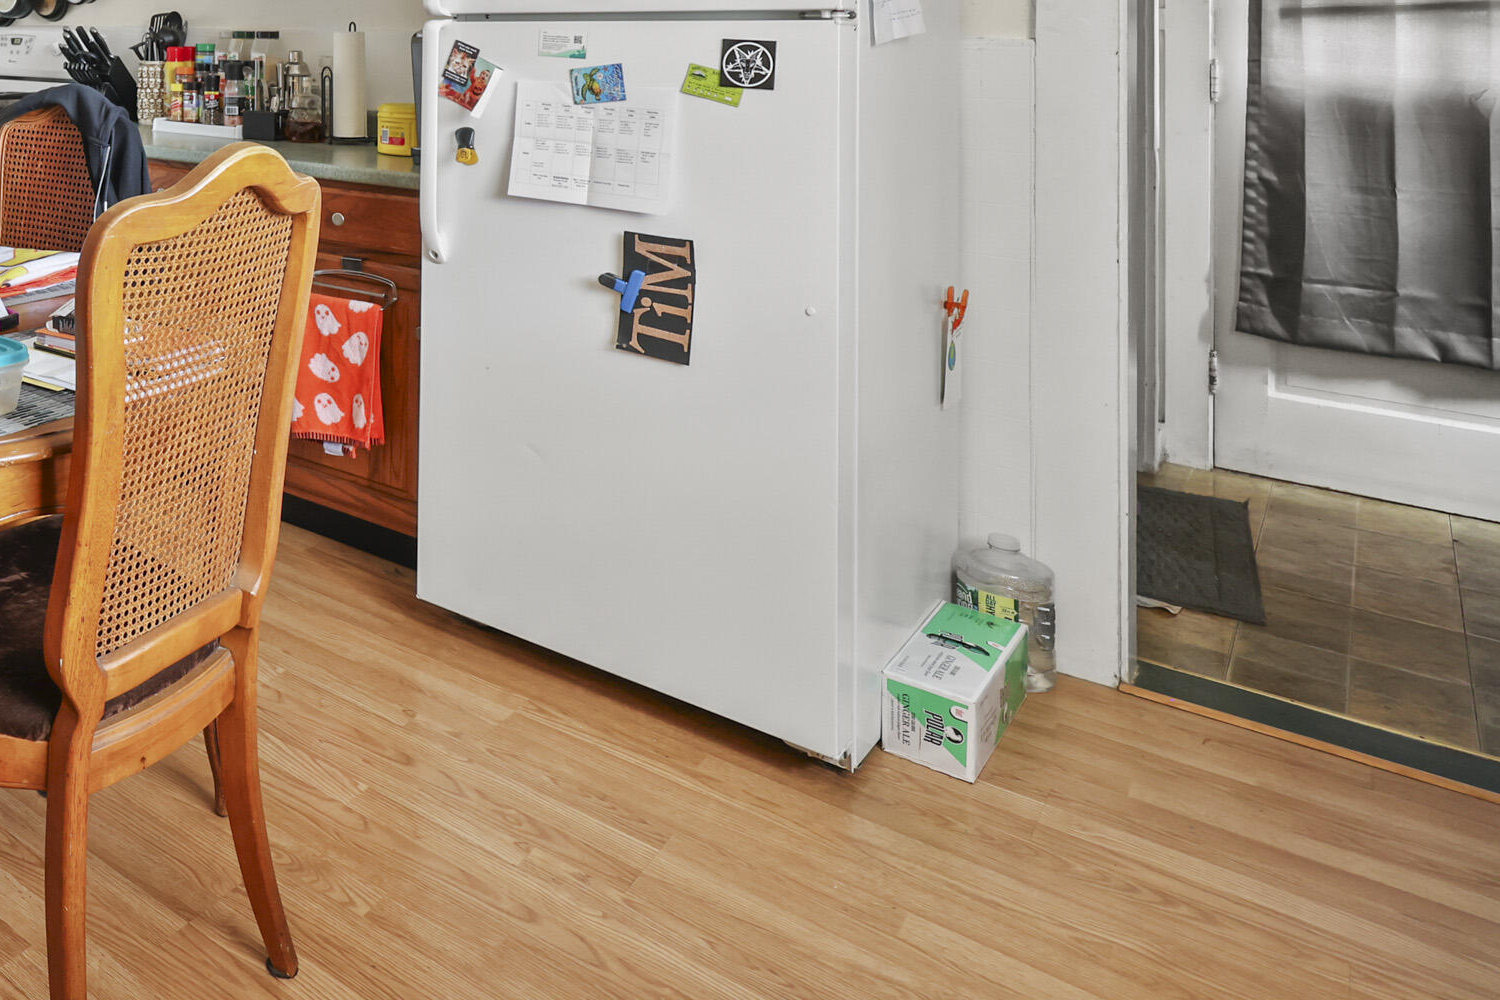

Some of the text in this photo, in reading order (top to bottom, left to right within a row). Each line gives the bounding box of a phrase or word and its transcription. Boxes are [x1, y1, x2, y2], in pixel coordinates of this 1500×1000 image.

[902, 693, 911, 746] GINGER ALE
[924, 709, 945, 746] POLAR
